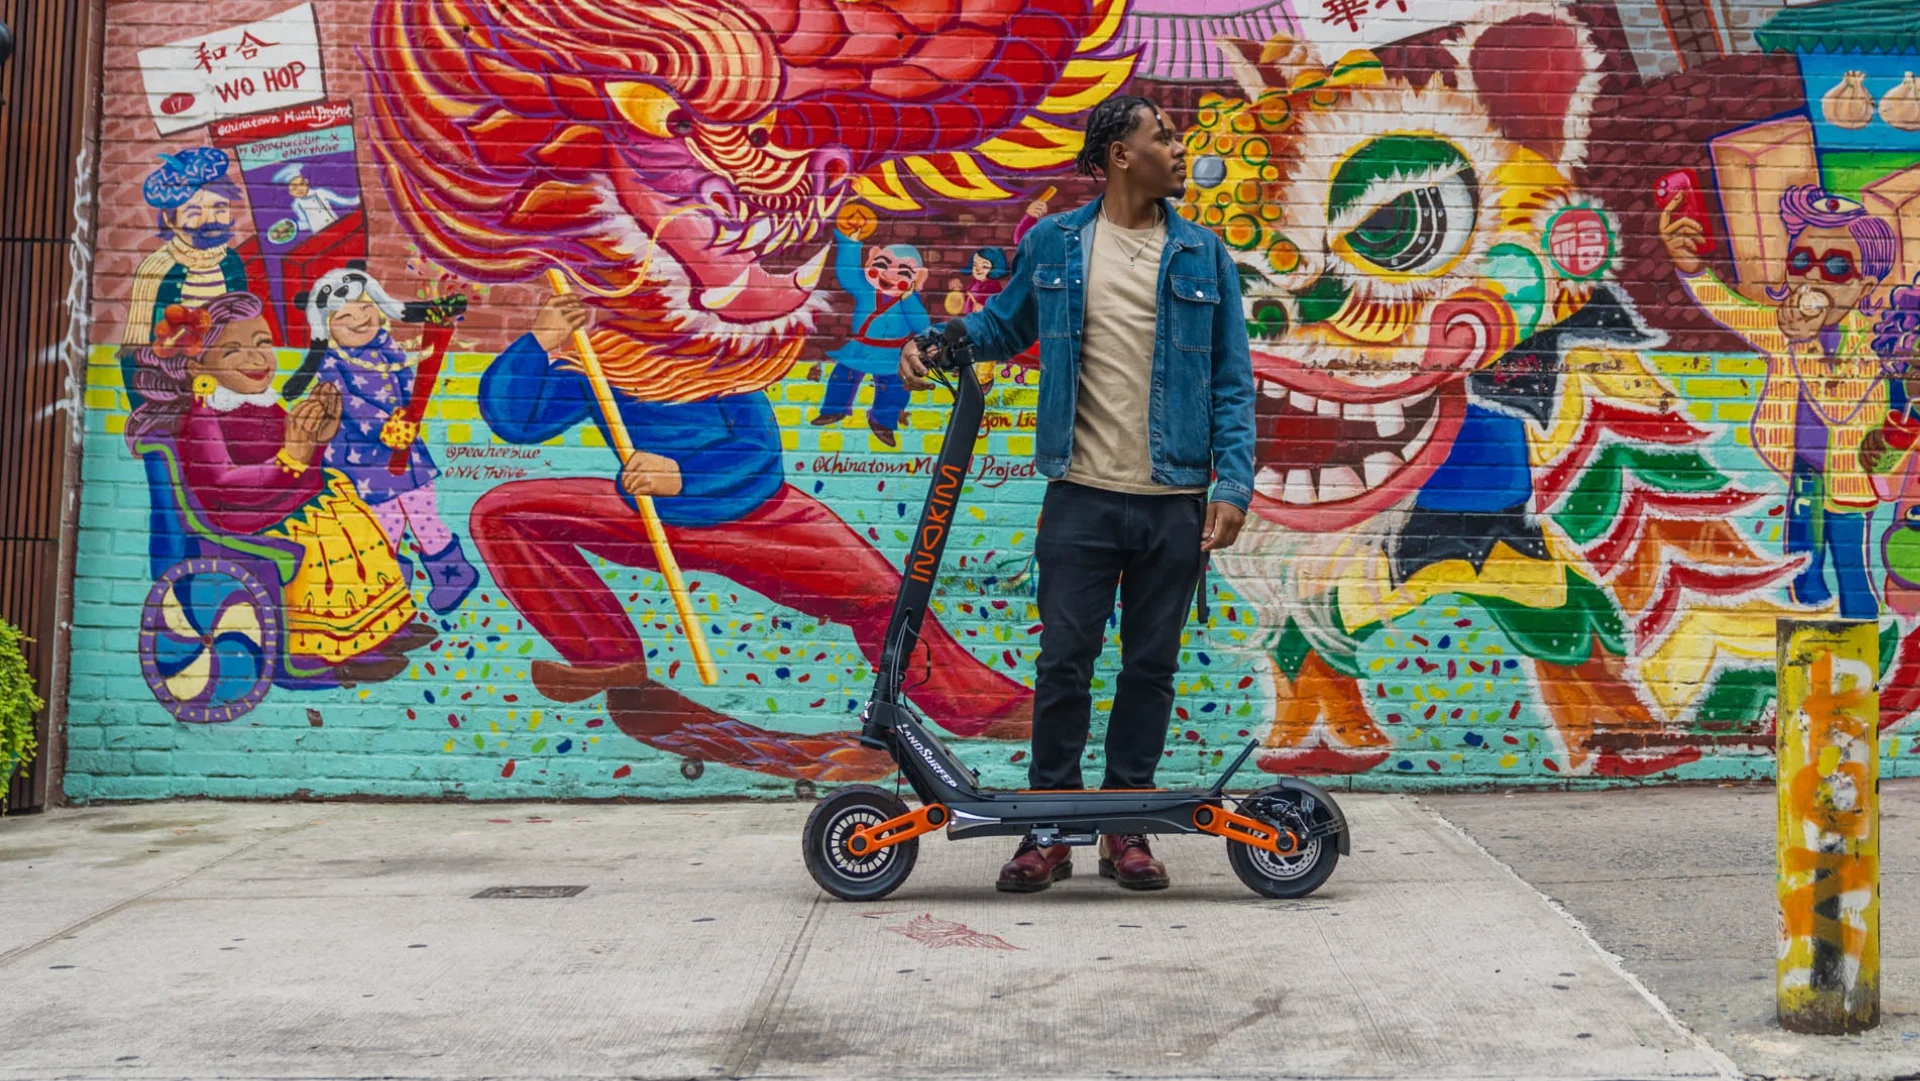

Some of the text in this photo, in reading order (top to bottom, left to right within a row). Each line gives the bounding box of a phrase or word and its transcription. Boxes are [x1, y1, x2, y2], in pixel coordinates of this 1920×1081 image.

[193, 30, 280, 74] 和合
[216, 61, 306, 103] WO HOP
[974, 455, 1037, 488] Project
[910, 464, 961, 583] INOKIM
